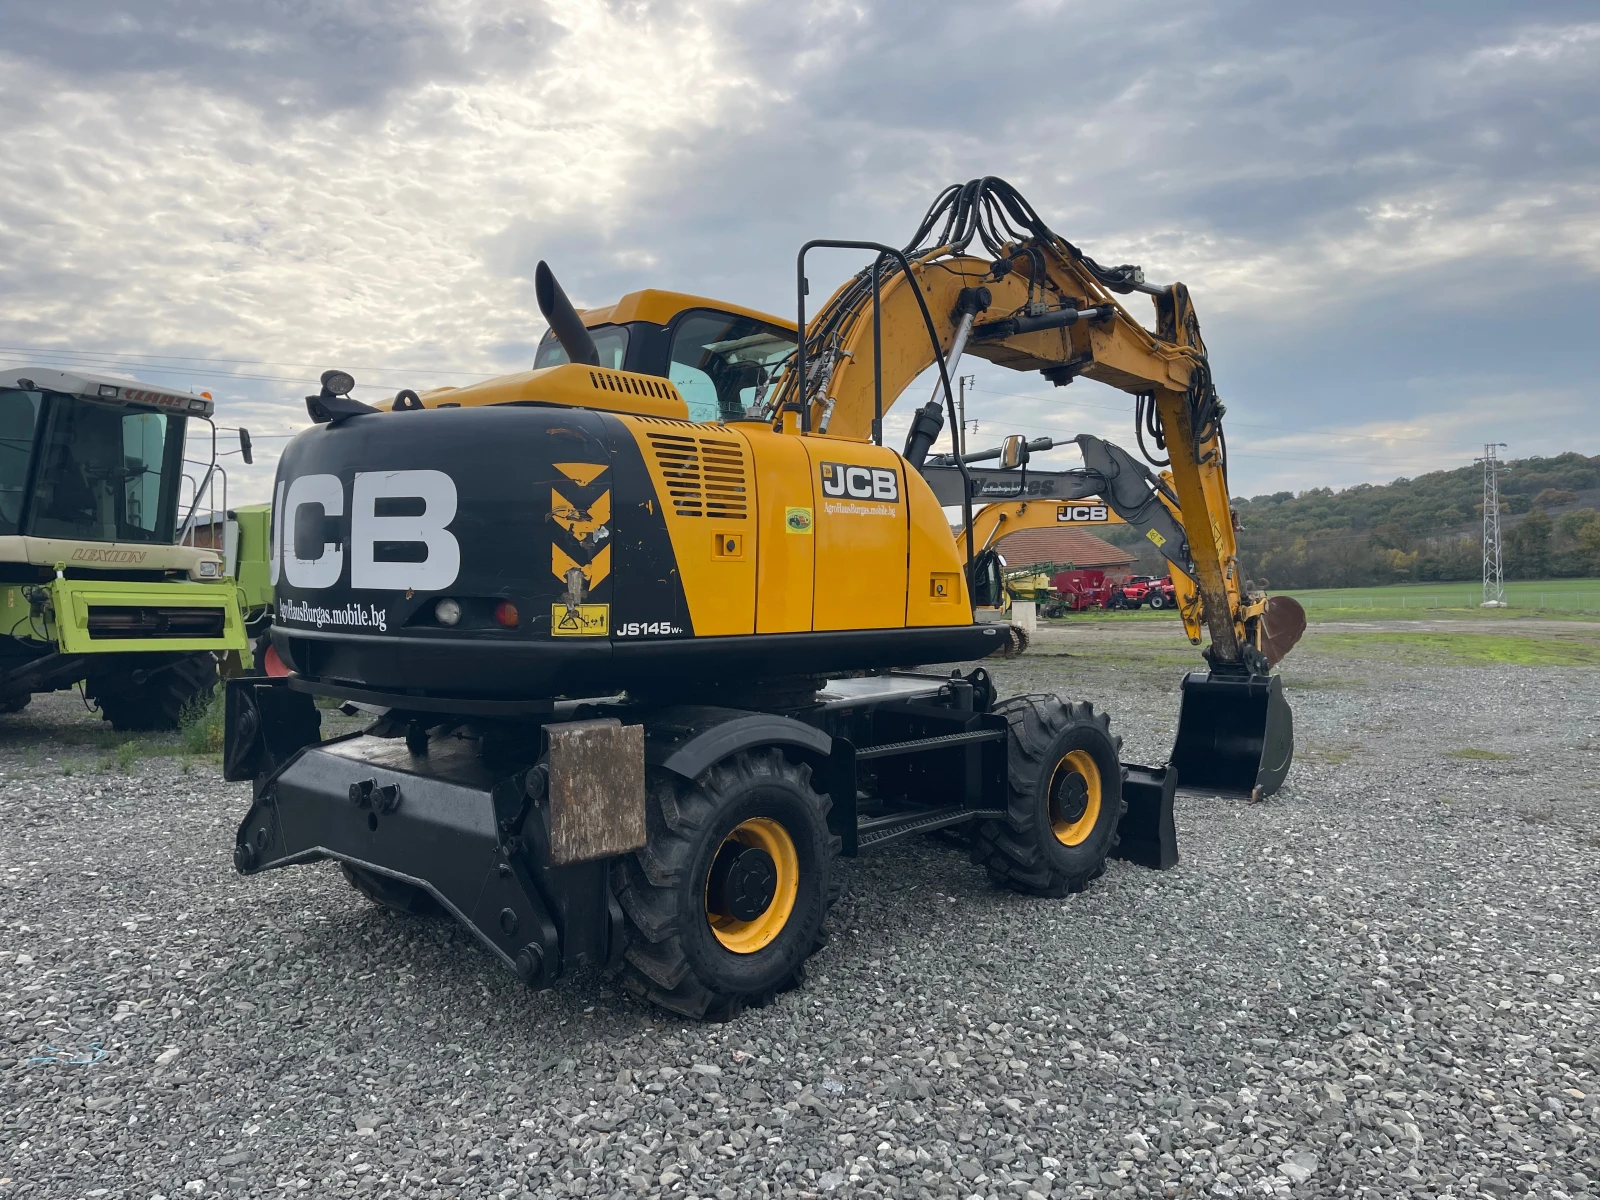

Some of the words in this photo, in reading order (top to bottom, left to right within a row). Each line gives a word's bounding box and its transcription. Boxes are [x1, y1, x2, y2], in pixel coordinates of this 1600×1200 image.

[124, 387, 189, 407] CLAAS
[823, 465, 898, 500] JCB
[823, 501, 897, 518] AgroHausBurgas.mobile.bg
[1058, 506, 1108, 521] JCB
[269, 469, 461, 591] JCB
[71, 548, 147, 564] LEXION
